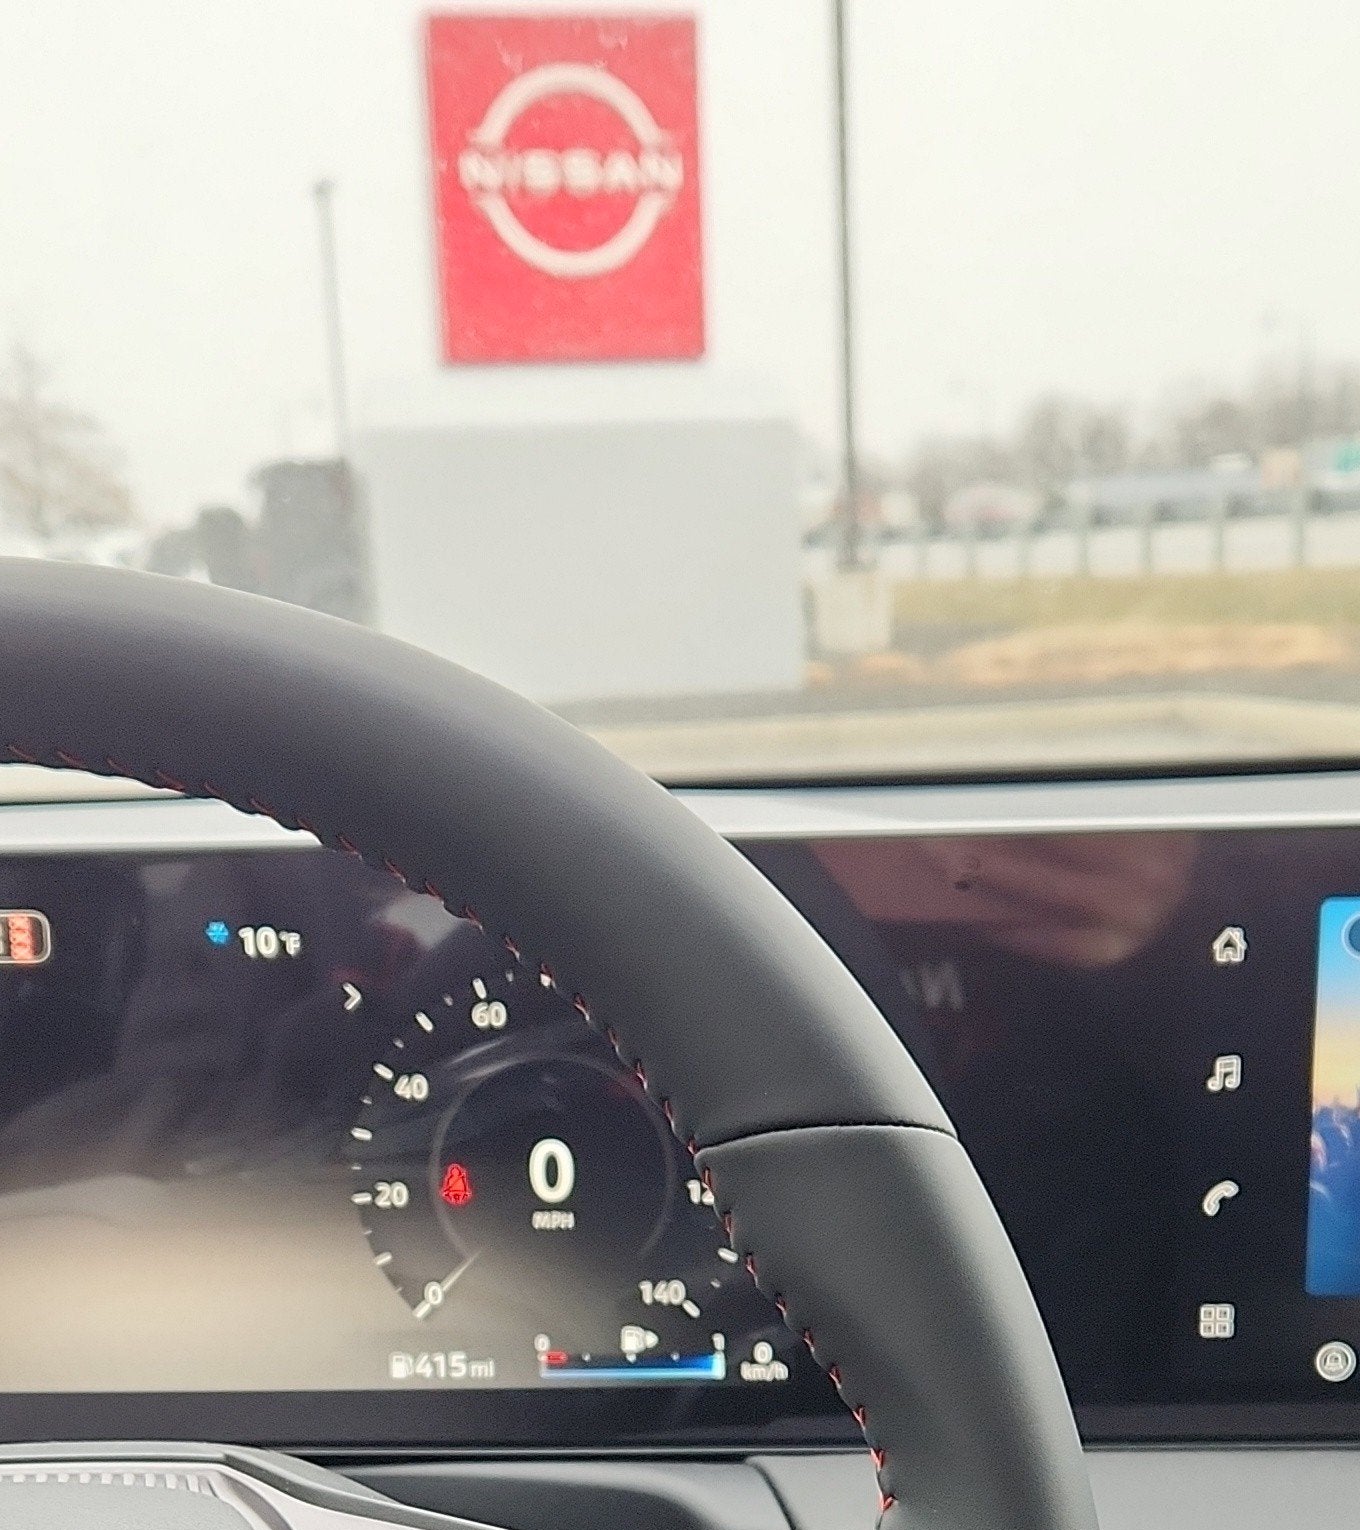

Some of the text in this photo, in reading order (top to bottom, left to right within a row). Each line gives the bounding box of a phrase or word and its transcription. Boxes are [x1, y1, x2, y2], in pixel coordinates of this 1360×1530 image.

[457, 149, 683, 197] NISSAN
[471, 1001, 507, 1029] 60
[394, 1074, 429, 1101] 40
[528, 1138, 575, 1203] 0
[375, 1181, 410, 1209] 20
[687, 1179, 715, 1206] 12
[532, 1210, 575, 1230] MPH
[424, 1281, 444, 1306] 0
[639, 1280, 687, 1306] 140
[534, 1333, 550, 1352] 0
[754, 1341, 774, 1363] 0
[740, 1360, 790, 1382] km/h
